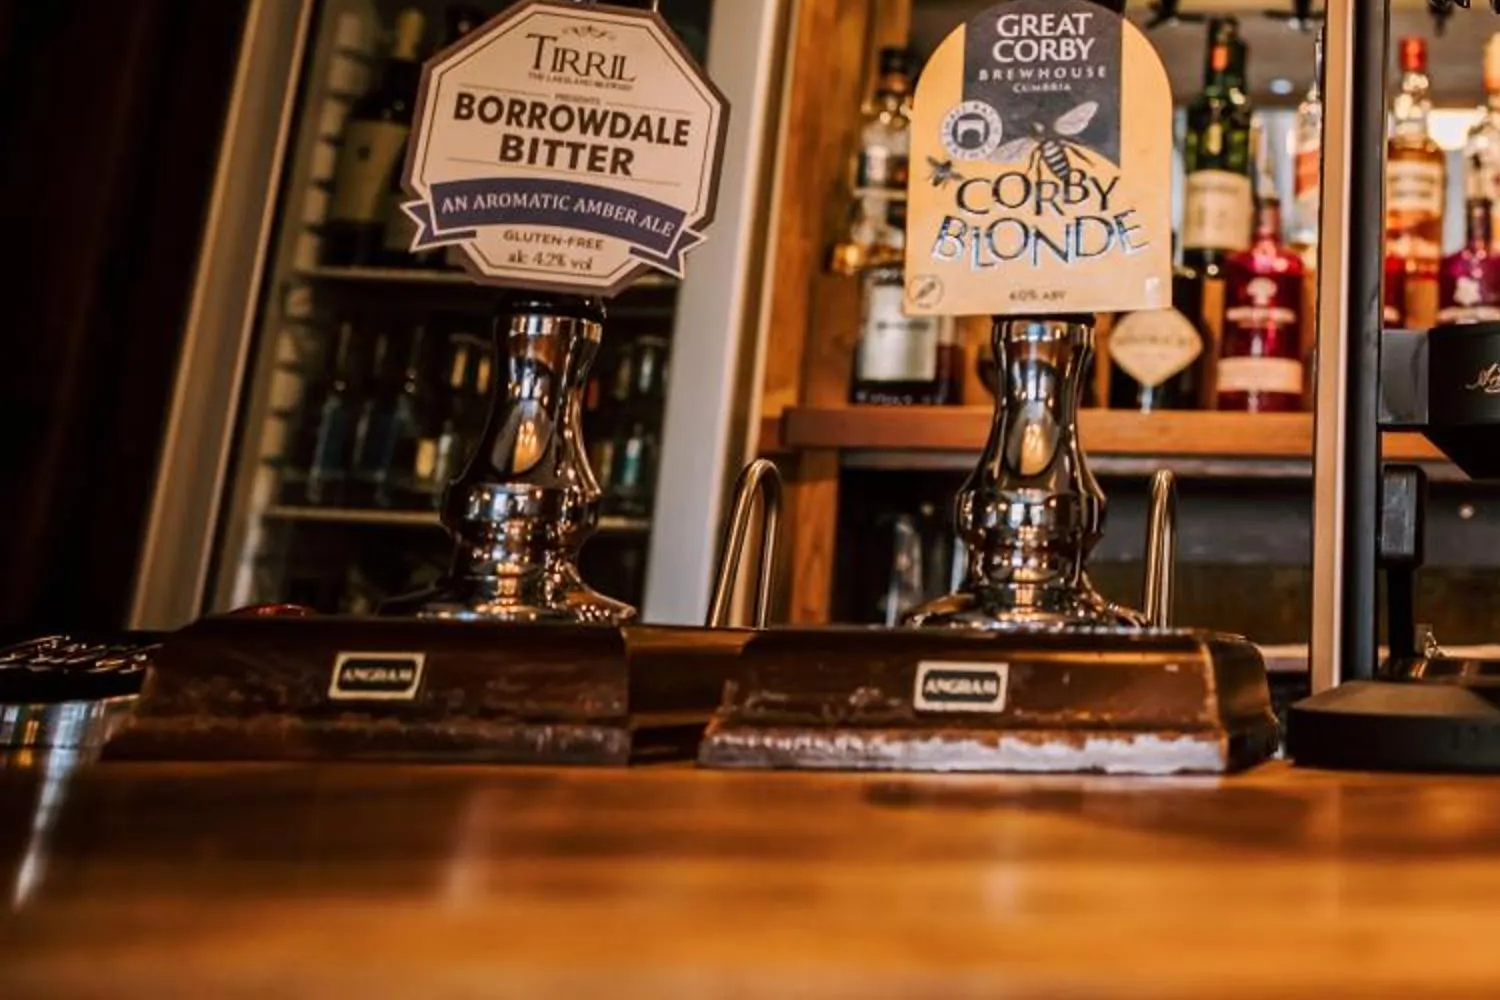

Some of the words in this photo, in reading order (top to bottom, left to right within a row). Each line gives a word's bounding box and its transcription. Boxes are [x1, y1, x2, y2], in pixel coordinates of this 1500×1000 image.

[997, 13, 1093, 37] GREAT
[992, 37, 1096, 63] CORBY
[978, 66, 1107, 81] BREWHOUSE
[1013, 83, 1071, 93] CUMBRIA
[453, 92, 691, 147] BORROWDALE
[500, 134, 635, 176] BITTER
[956, 168, 1121, 216] CORBY
[441, 196, 468, 215] AN
[473, 193, 570, 213] AROMATIC
[574, 196, 637, 226] AMBER
[639, 217, 675, 238] ALE
[503, 229, 604, 250] GLUTEN-FREE
[932, 209, 1150, 270] BLONDE
[571, 256, 593, 270] vol
